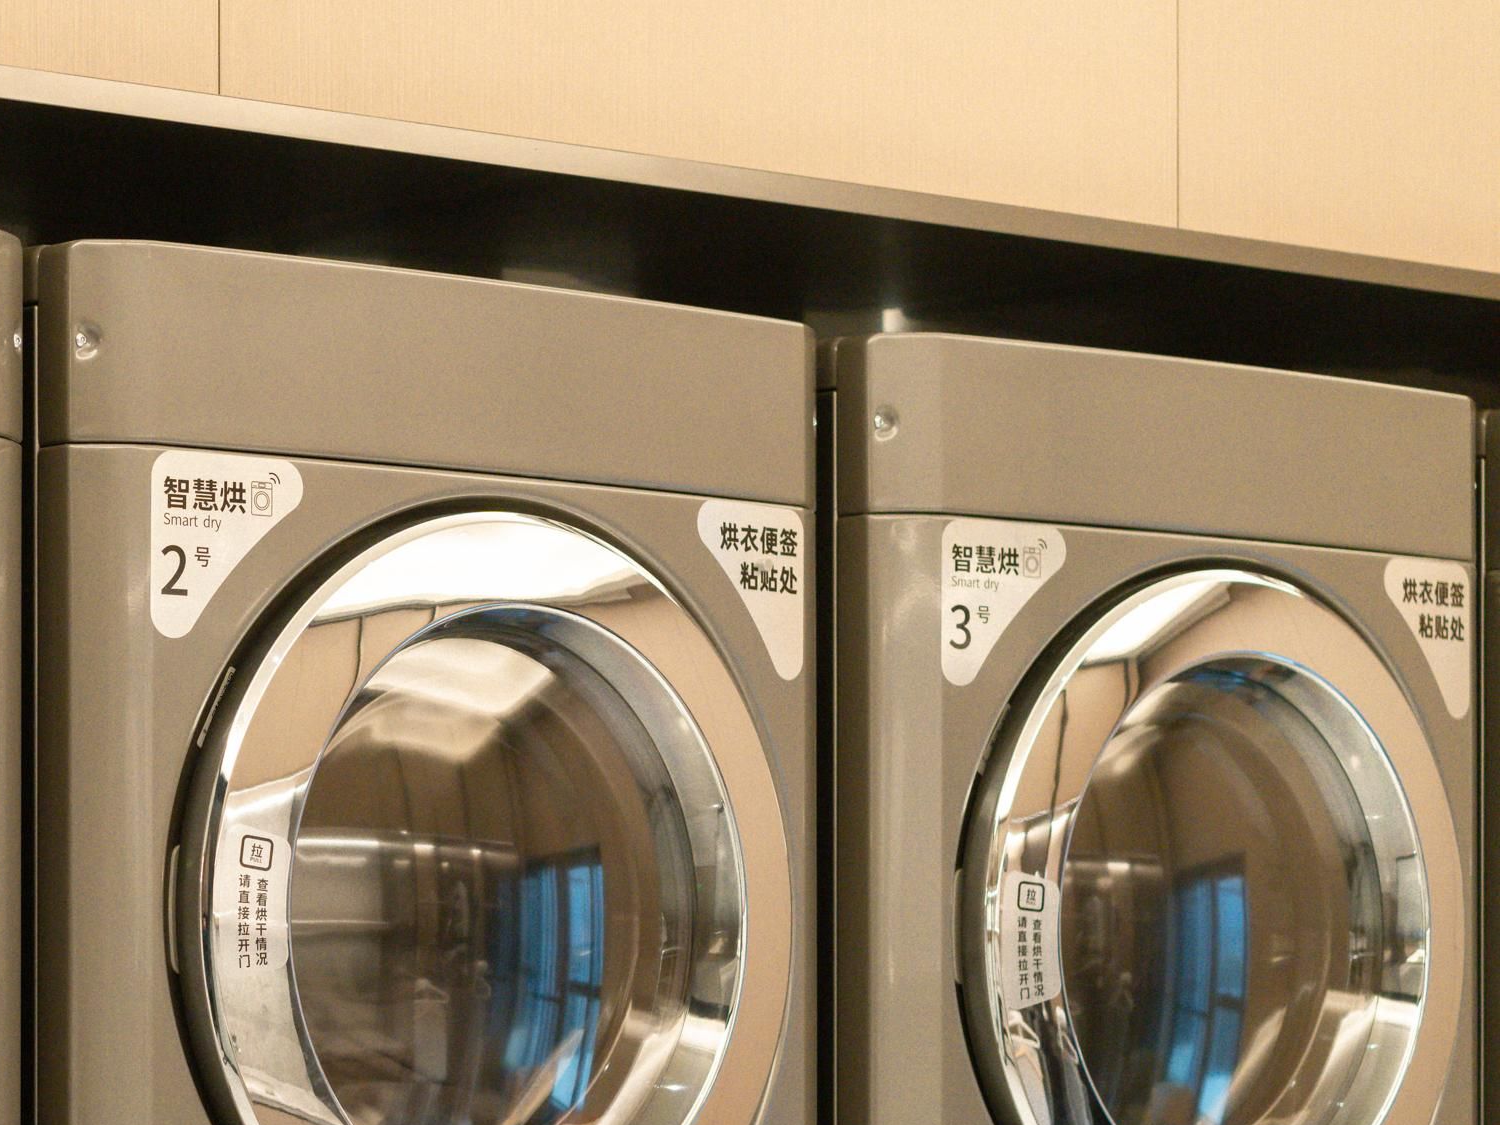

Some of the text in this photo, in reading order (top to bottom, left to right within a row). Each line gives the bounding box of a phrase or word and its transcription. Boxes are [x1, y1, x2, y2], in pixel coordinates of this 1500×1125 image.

[163, 476, 247, 515] 智慧烘
[163, 512, 222, 533] Smart dry
[720, 522, 798, 557] 烘衣便签
[160, 544, 212, 597] 2 号
[951, 543, 1020, 576] 智慧烘
[740, 561, 798, 595] 粘贴处
[951, 575, 1000, 593] Smart dry
[1402, 577, 1465, 608] 烘衣便签
[949, 604, 991, 650] 3 号
[1418, 613, 1465, 642] 粘贴处
[251, 843, 263, 859] 拉
[1026, 888, 1036, 901] 拉
[237, 874, 251, 969] 请直接拉开门
[255, 878, 269, 966] 查看烘干情况
[1017, 916, 1030, 1000] 请直接拉开门
[1032, 919, 1044, 997] 查看烘干情况
